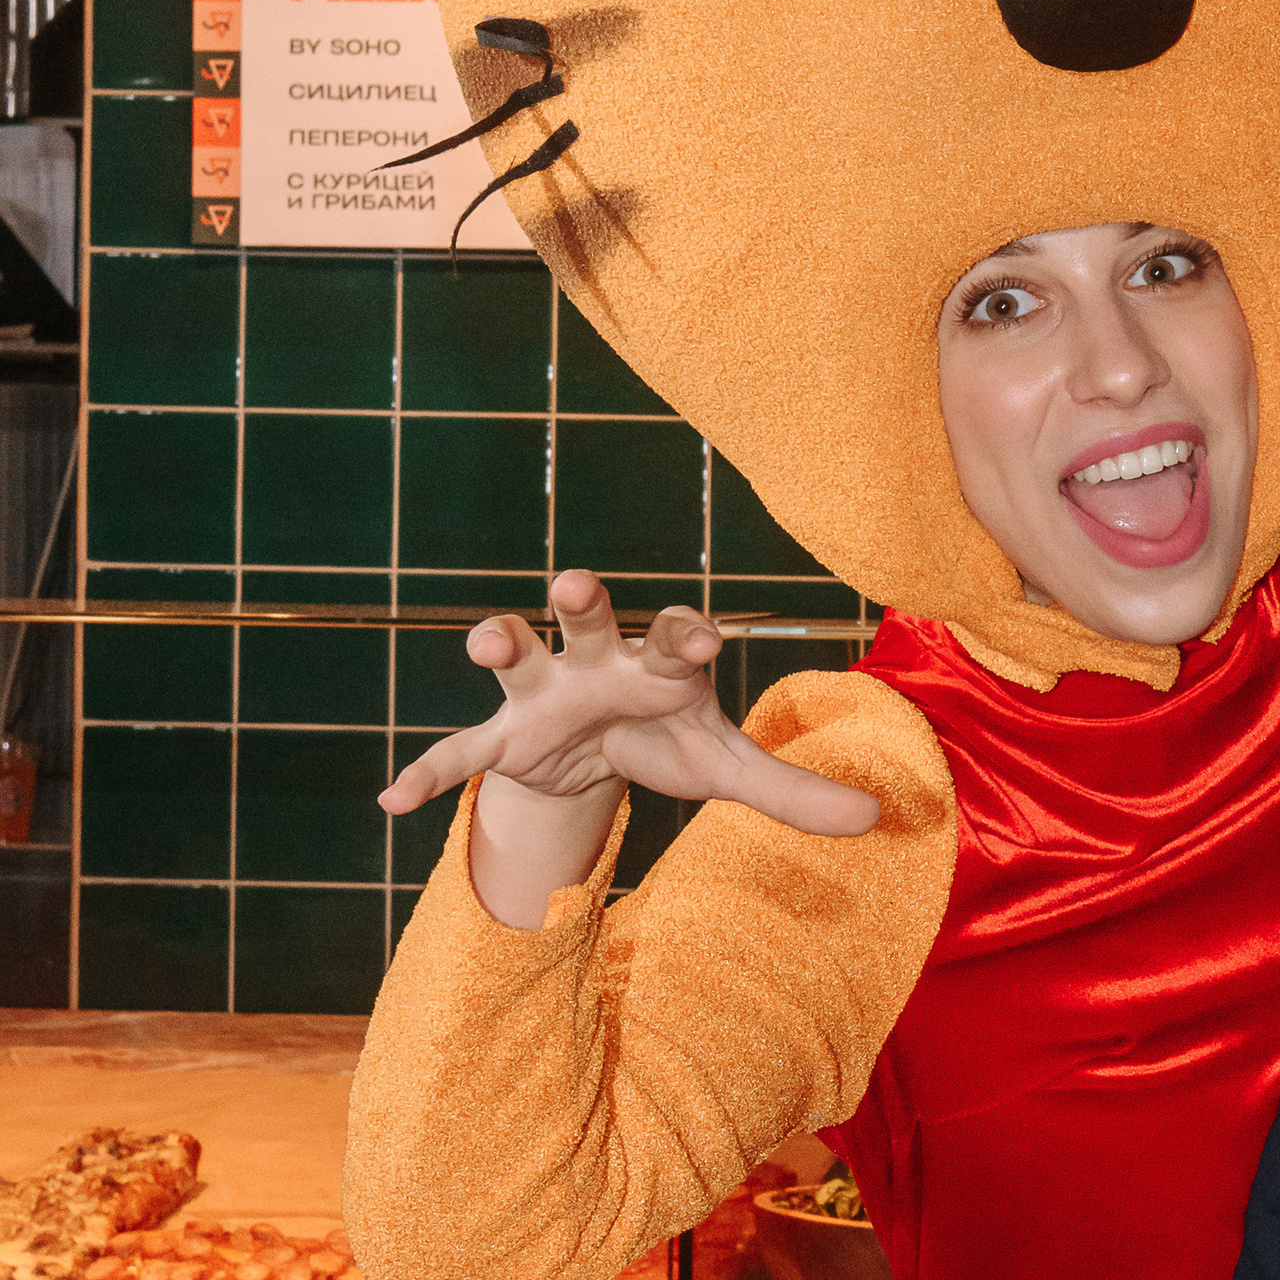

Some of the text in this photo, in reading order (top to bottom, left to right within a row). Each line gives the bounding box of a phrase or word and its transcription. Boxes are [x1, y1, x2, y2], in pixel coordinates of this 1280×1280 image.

[290, 39, 401, 56] BY SOHO
[289, 83, 437, 102] СИЦИЛИЕЦ
[289, 129, 429, 147] ПЕПЕРОНИ
[287, 171, 434, 191] С КУРИЦЕЙ
[312, 194, 436, 212] ГРИБАМИ
